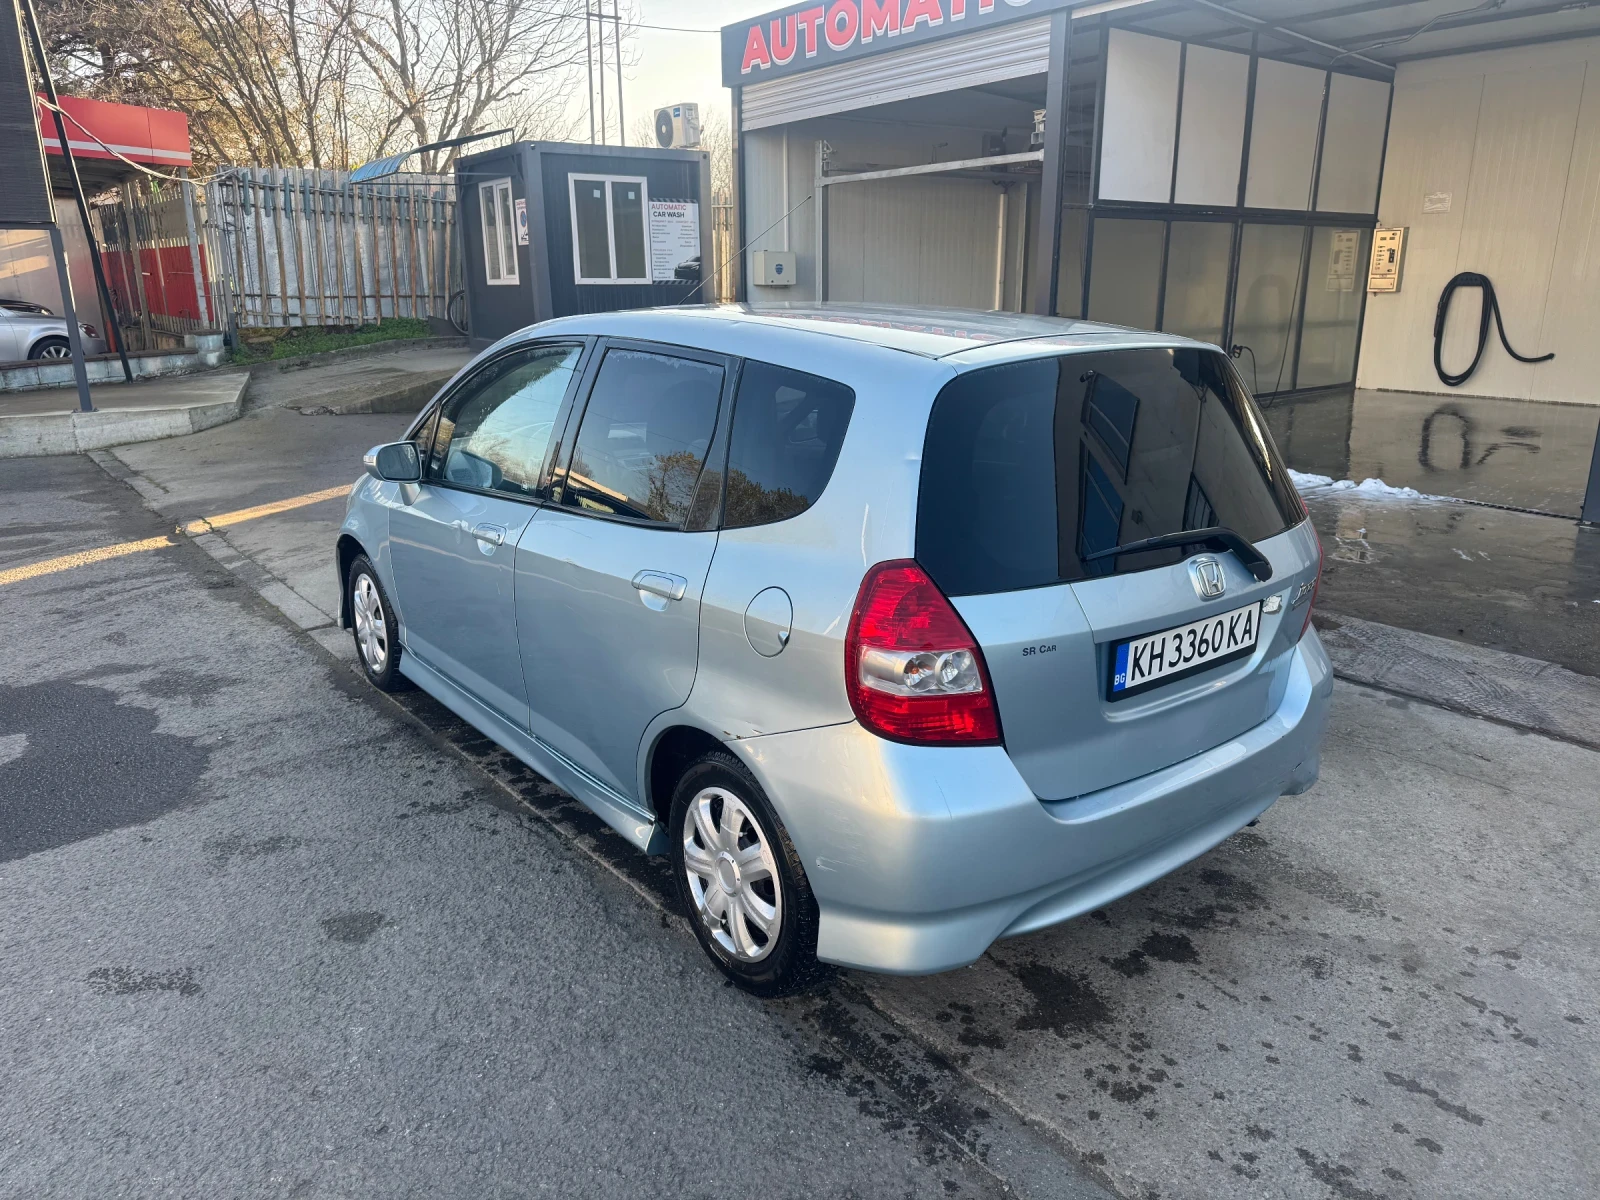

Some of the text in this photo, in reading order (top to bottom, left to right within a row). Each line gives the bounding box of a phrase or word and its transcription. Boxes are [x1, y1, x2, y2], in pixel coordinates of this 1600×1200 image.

[741, 0, 1033, 75] AUTOMA
[1022, 646, 1036, 657] SR
[1114, 672, 1126, 686] BG
